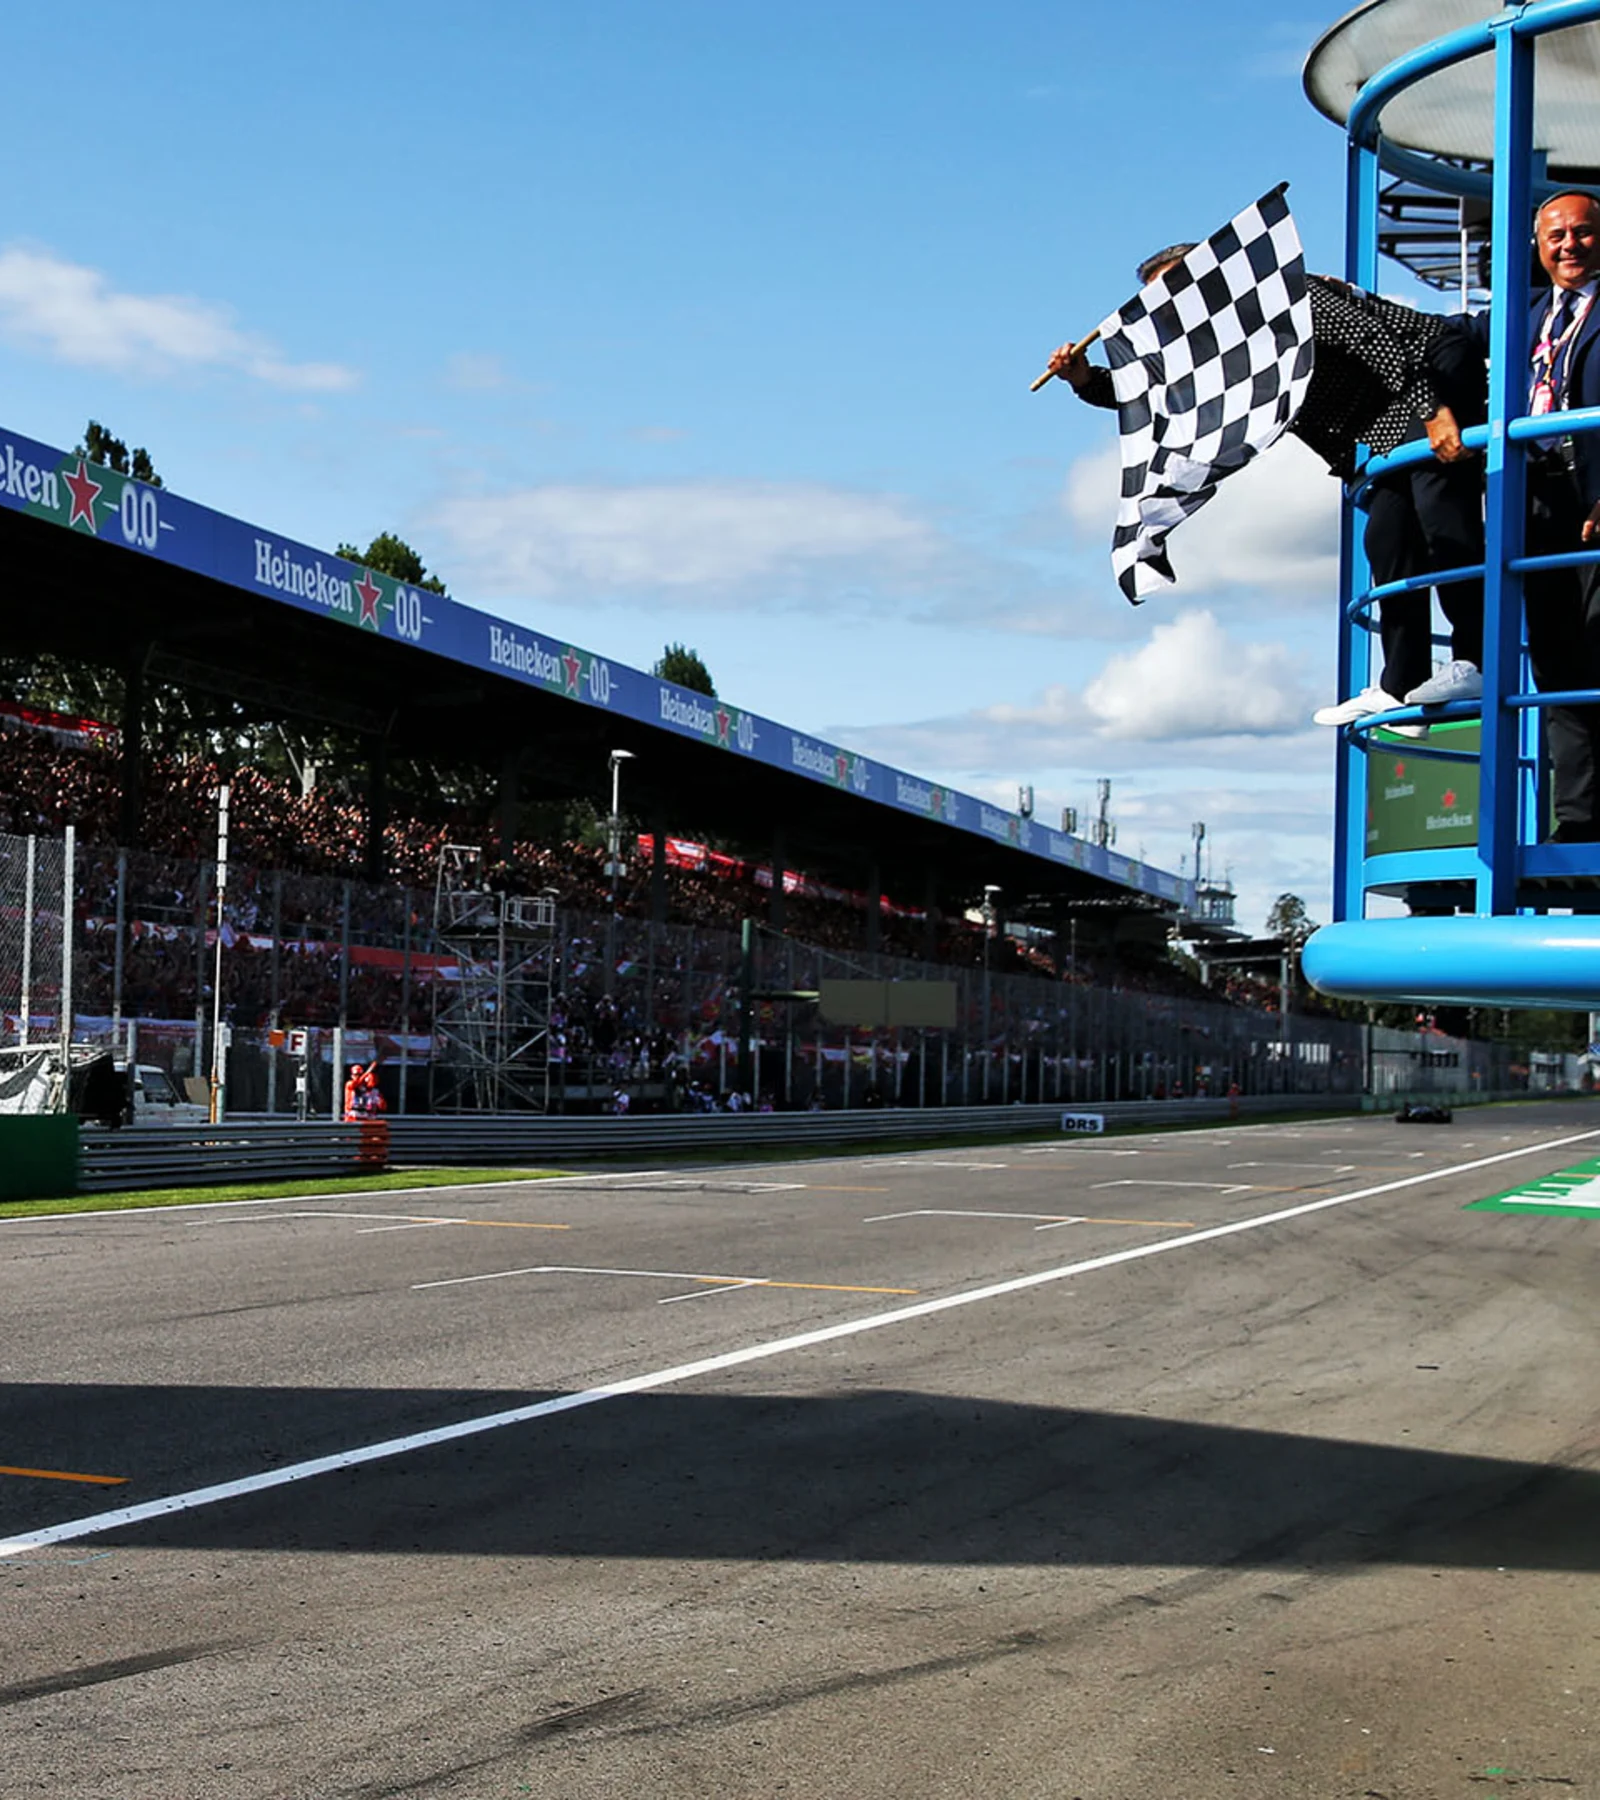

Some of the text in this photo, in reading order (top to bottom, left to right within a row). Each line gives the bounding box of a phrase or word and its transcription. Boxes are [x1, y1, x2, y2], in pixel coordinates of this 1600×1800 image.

[121, 481, 158, 550] 0.0
[255, 539, 354, 613] Heineken
[490, 625, 562, 684] Heineken
[660, 686, 715, 735] Heineken
[291, 1034, 304, 1051] F
[1065, 1117, 1099, 1131] DRS
